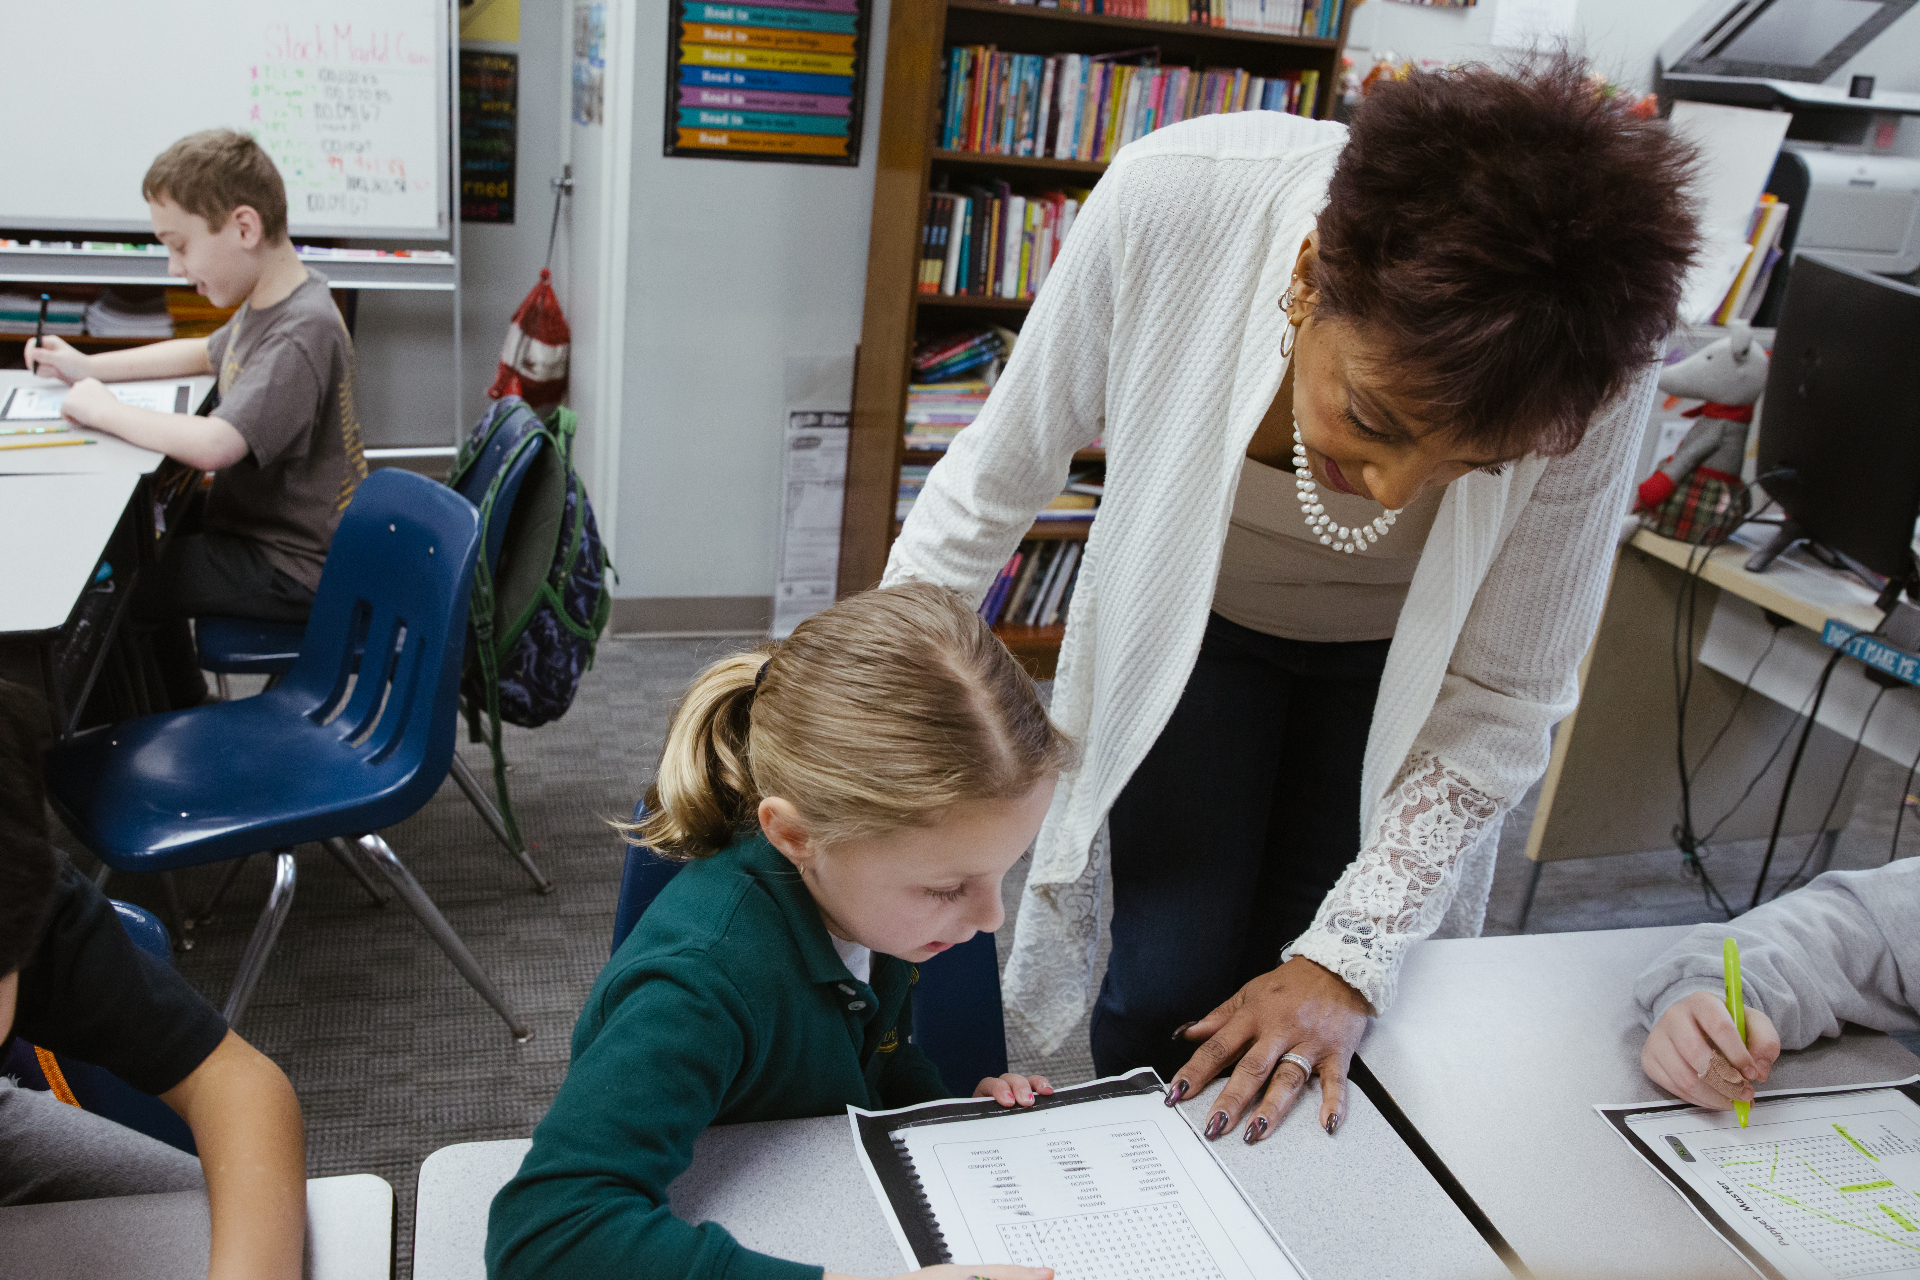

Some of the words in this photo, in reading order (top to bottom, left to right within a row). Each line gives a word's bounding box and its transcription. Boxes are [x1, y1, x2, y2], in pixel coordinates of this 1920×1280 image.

[704, 6, 734, 20] Read
[704, 28, 732, 41] Read
[702, 49, 731, 62] Read
[702, 70, 730, 83] Read
[701, 92, 730, 104] Read
[700, 112, 728, 124] Read
[699, 133, 728, 145] Read
[1862, 642, 1900, 672] MAKE
[1897, 657, 1919, 681] ME
[1716, 1180, 1754, 1212] Master
[1752, 1216, 1790, 1246] Puppet
